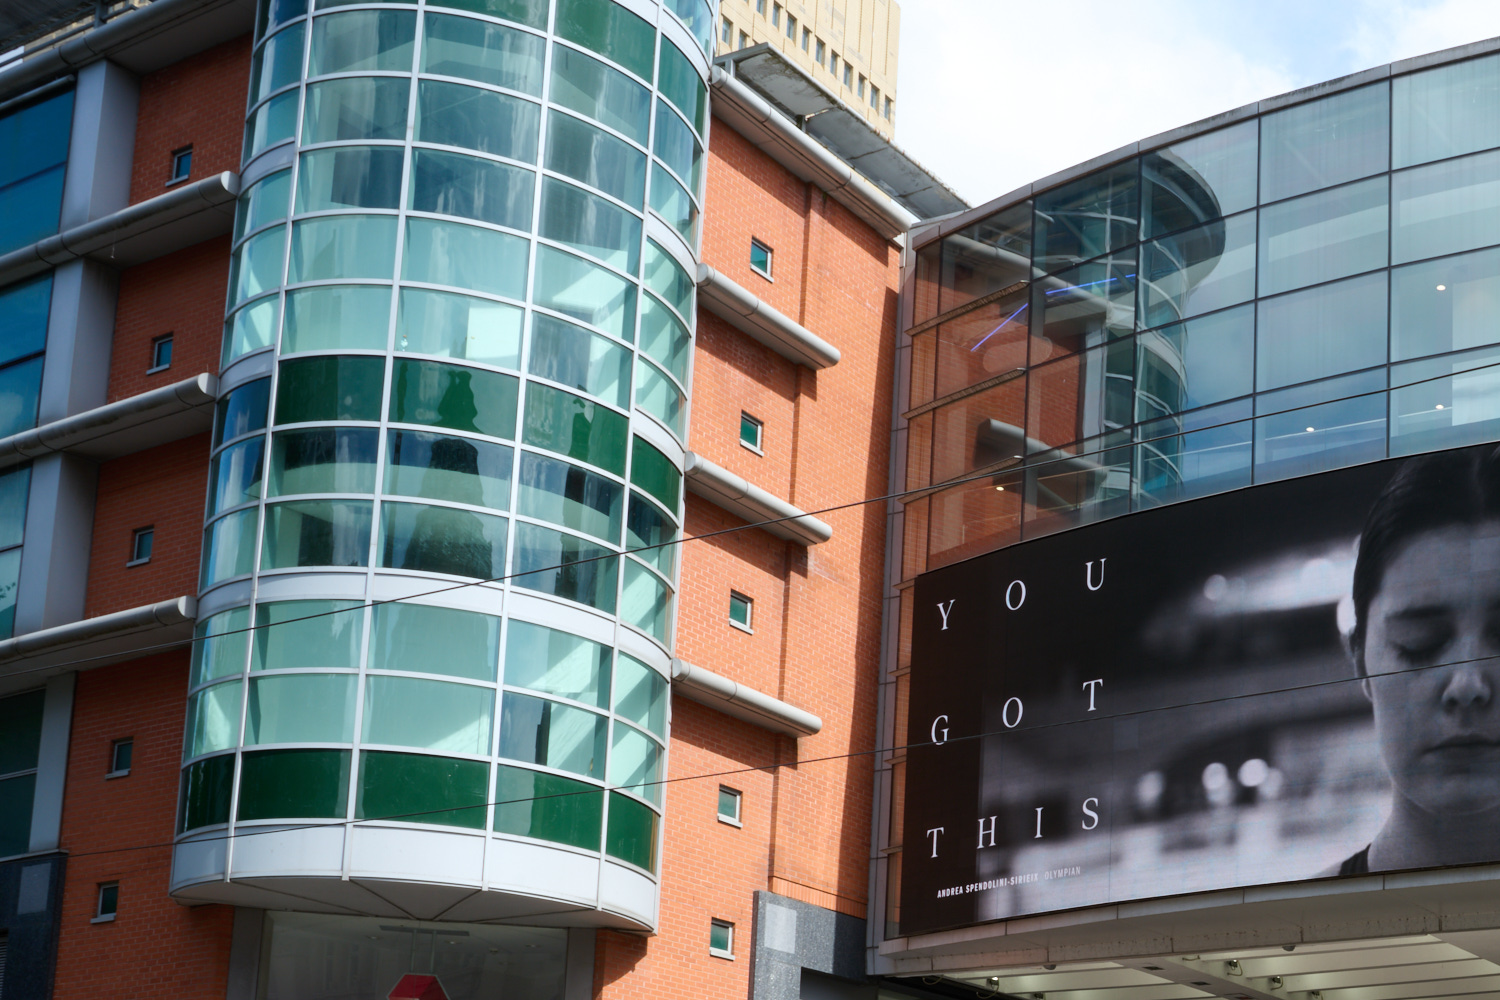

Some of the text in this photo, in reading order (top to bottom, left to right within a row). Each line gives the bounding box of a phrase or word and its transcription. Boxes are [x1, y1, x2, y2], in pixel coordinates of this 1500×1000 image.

[937, 558, 1107, 630] YOU
[931, 678, 1103, 745] GOT
[927, 797, 1099, 859] THIS
[937, 886, 963, 898] ANDREA
[1045, 866, 1081, 880] OLYMPIAN
